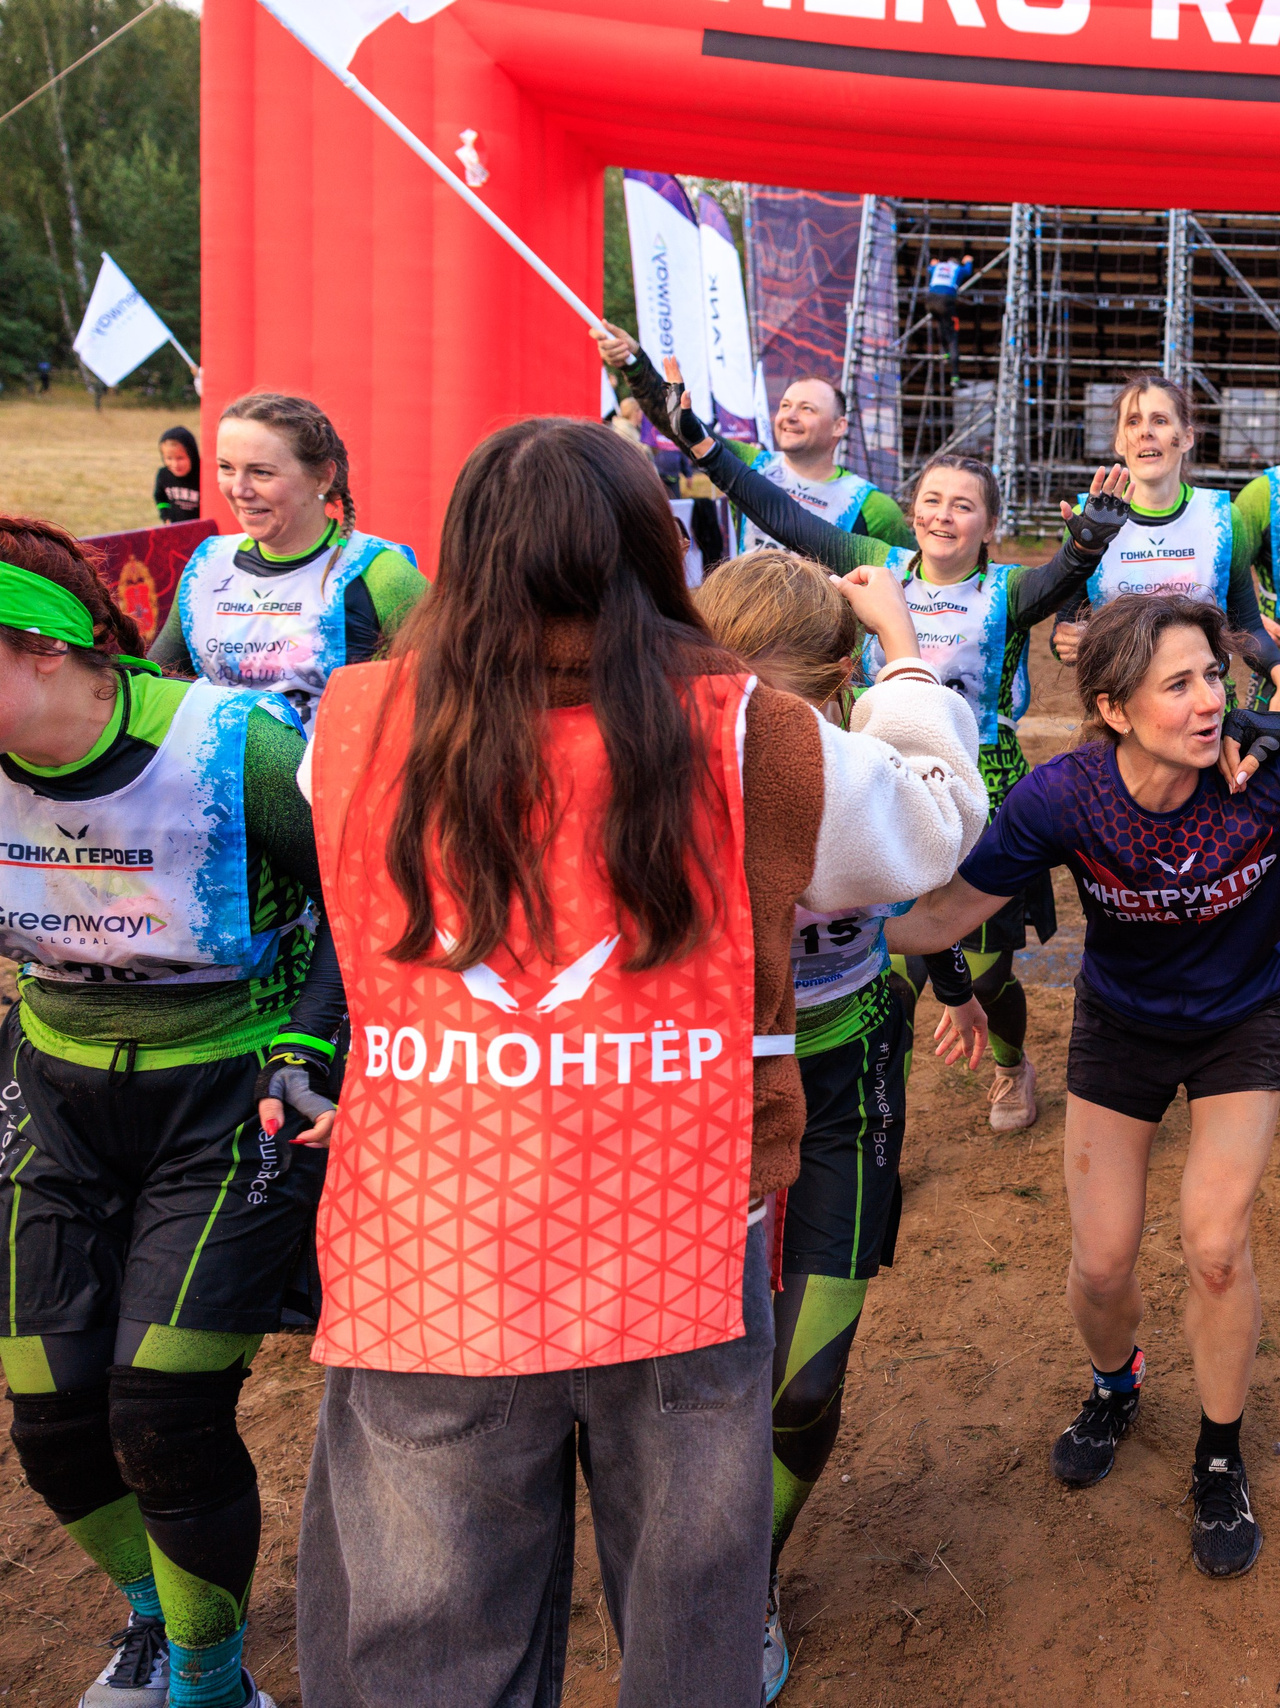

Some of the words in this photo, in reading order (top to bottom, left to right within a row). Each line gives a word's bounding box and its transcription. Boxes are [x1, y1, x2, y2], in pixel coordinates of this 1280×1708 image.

[1120, 550, 1154, 560] ГОНКА
[1156, 548, 1195, 557] ГЕРОЕВ
[216, 602, 253, 612] ГОНКА
[256, 602, 302, 612] ГЕРОЕВ
[933, 601, 968, 613] ГЕРОЕВ
[206, 637, 286, 655] Greenway
[75, 847, 154, 865] ГЕРОЕВ
[1082, 853, 1277, 909] ИНСТРУКТОР
[1103, 908, 1180, 922] ГОНКА
[36, 935, 109, 945] GLOBAL
[364, 1019, 723, 1088] ВОЛОНТЁР
